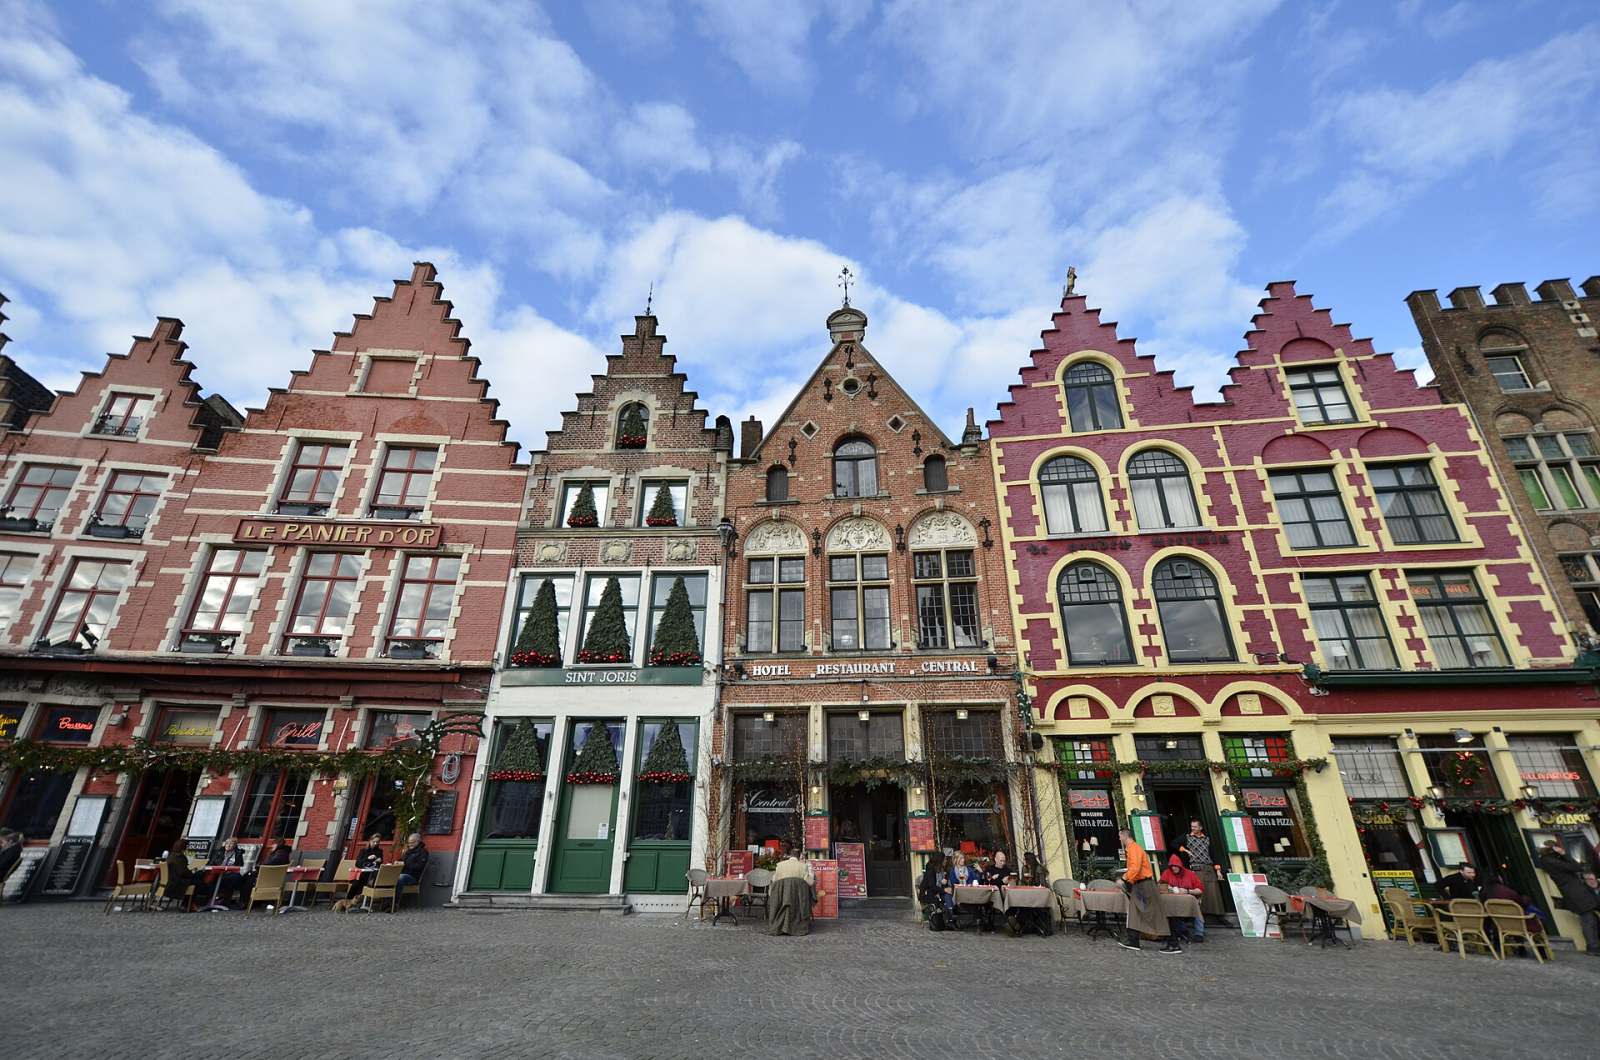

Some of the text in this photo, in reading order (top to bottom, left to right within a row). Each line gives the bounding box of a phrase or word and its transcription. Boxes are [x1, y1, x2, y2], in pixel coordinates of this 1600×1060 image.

[243, 525, 277, 540] LE
[281, 523, 373, 543] PANIER
[752, 661, 978, 676] HOTEL RESTAURANT CENTRAL
[565, 671, 637, 683] SINT JORIS
[58, 716, 94, 730] Brasserie
[274, 722, 321, 745] Grill
[749, 789, 793, 807] Central
[944, 790, 988, 808] Central
[1069, 793, 1110, 808] Pasta
[1246, 792, 1288, 808] Pizza
[1074, 819, 1091, 827] PASTA
[1097, 819, 1114, 827] PIZZA
[1252, 817, 1271, 826] PASTA
[1276, 818, 1295, 826] PIZZA
